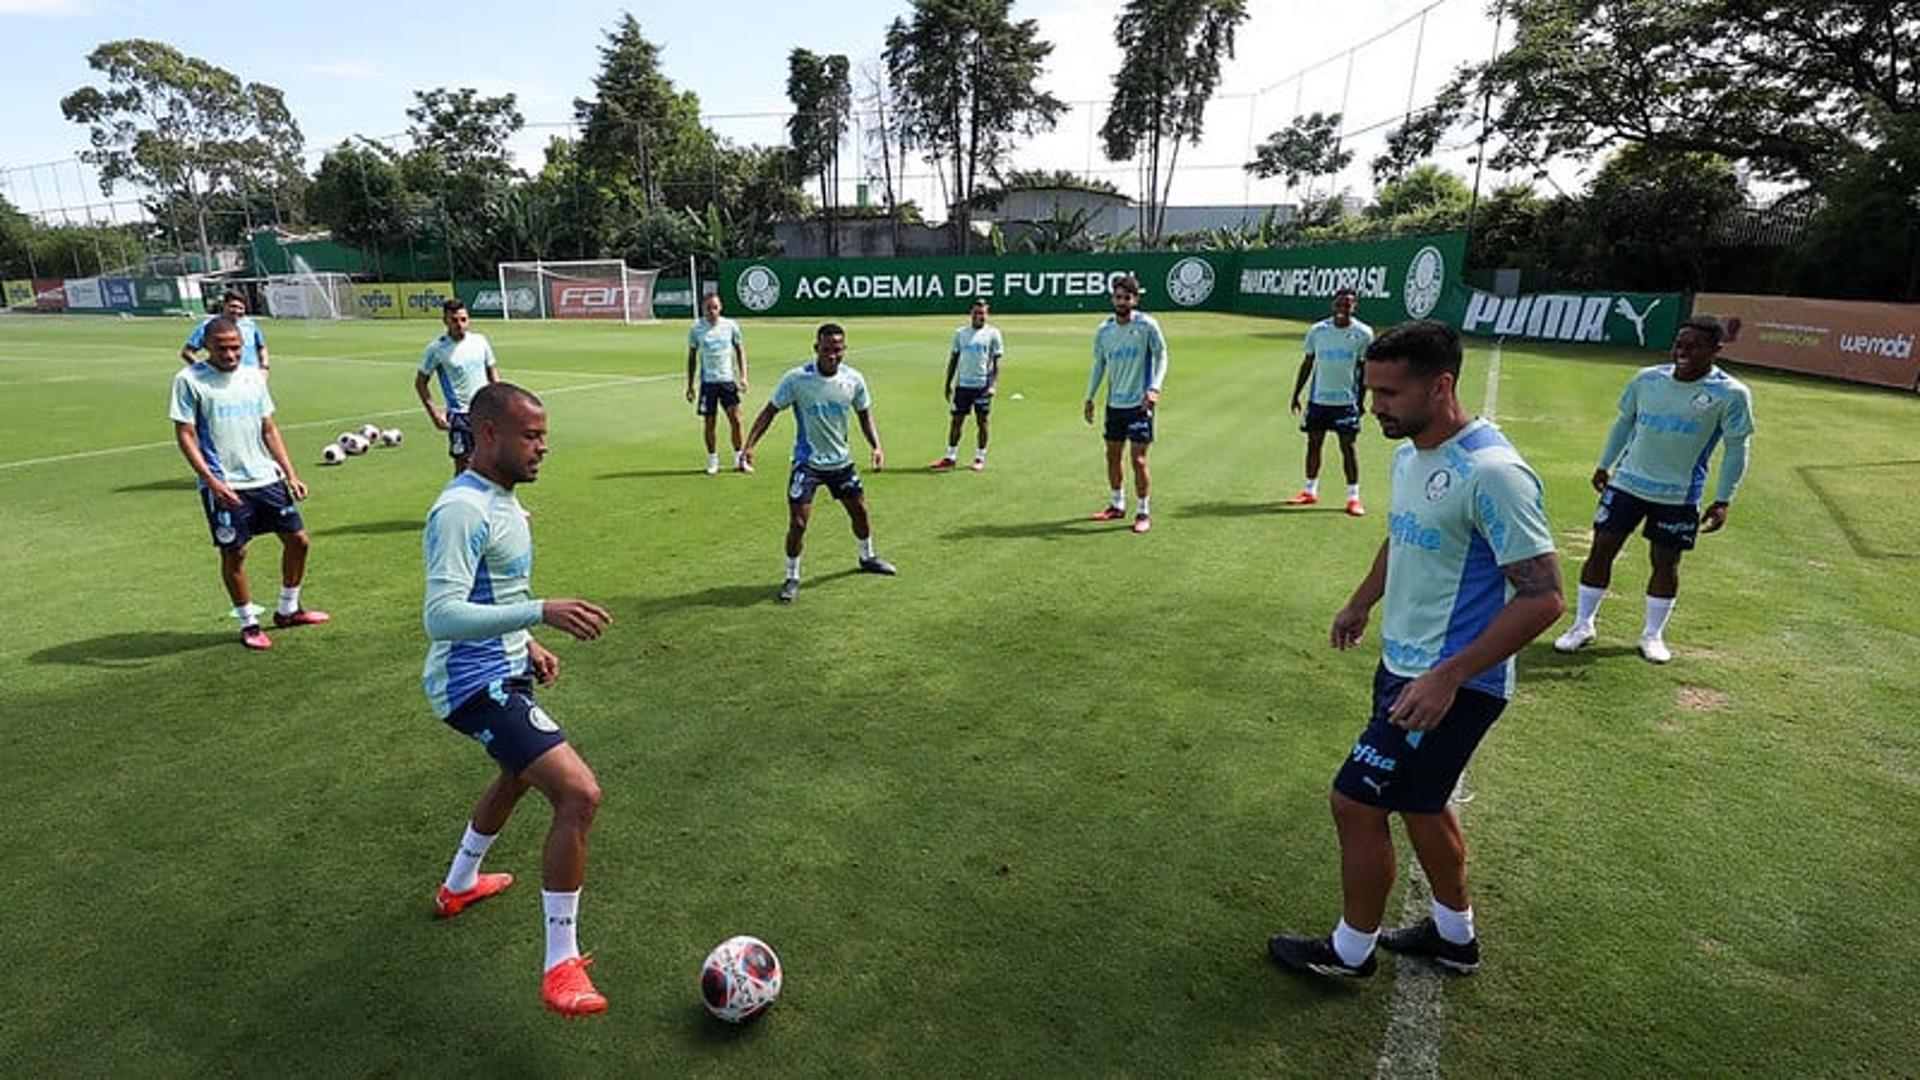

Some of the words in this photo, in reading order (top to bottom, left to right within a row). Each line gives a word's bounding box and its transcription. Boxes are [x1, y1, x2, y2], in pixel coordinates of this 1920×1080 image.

[795, 275, 944, 299] ACADEMIA
[954, 273, 994, 296] DE
[1462, 291, 1611, 341] PUMA
[1840, 333, 1915, 359] wemobi
